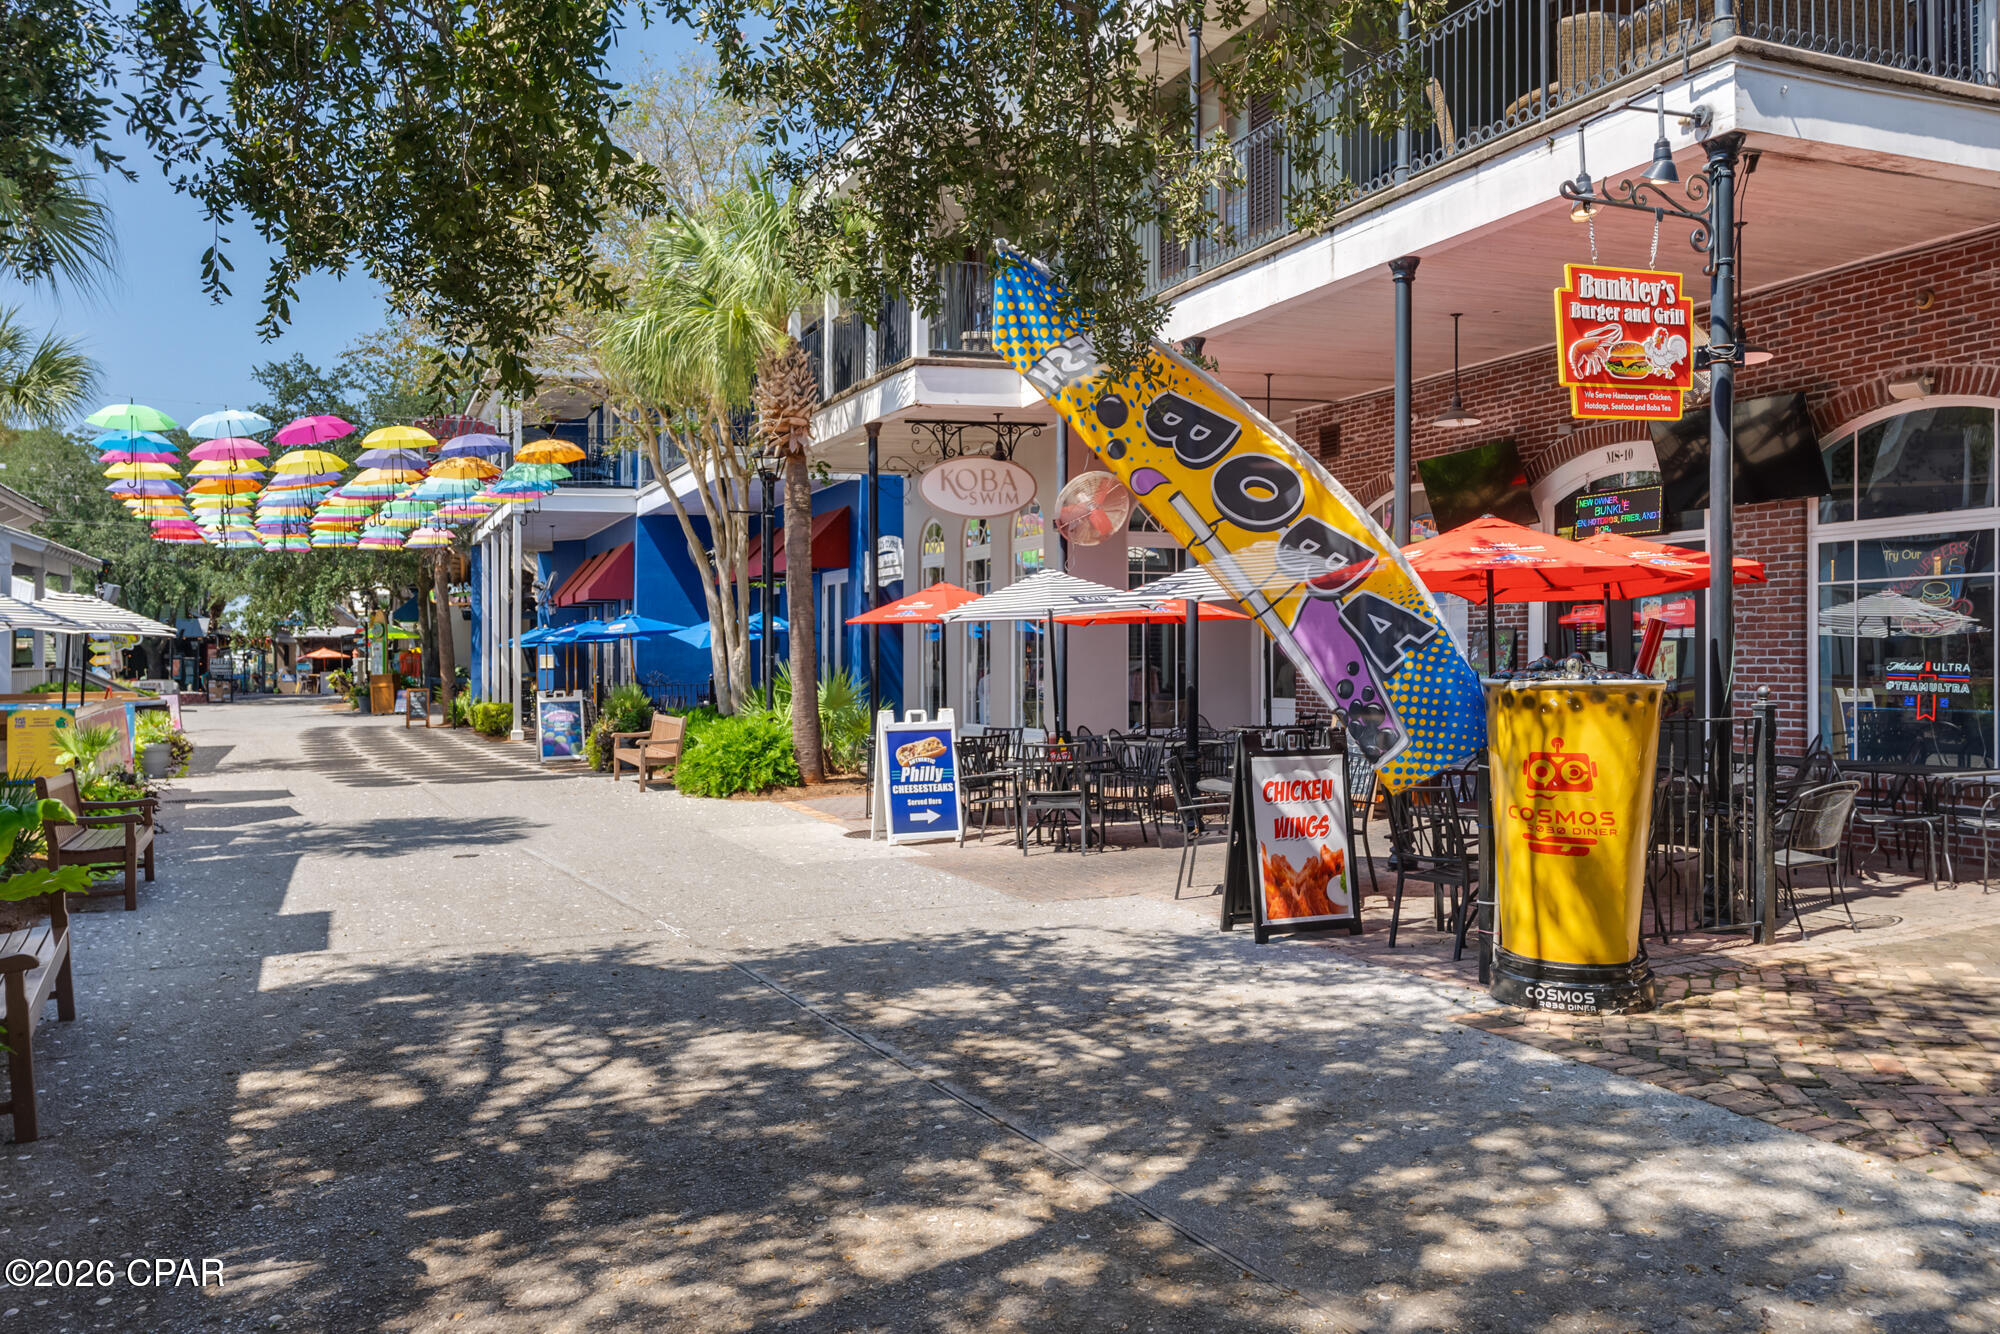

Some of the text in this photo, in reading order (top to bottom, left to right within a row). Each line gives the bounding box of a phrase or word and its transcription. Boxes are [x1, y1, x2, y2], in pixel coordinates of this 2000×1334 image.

[1578, 273, 1676, 307] Bunkley's
[1570, 302, 1685, 326] Burger and Grill
[1584, 390, 1673, 402] We Serve Hamburgers, Chicken,
[1584, 402, 1611, 412] Hotdogs,
[1611, 402, 1635, 412] Seafood
[1646, 404, 1661, 412] Boba
[1661, 404, 1672, 412] Tea
[1606, 447, 1634, 464] MS-10
[940, 468, 1018, 500] KOBA
[969, 492, 1020, 506] SWIM
[1578, 498, 1594, 508] NEW
[1883, 549, 1922, 563] Try Our
[1932, 662, 1971, 673] ULTRA
[900, 765, 944, 783] Philly
[892, 782, 954, 795] CHEESESTEAKS
[1263, 779, 1333, 803] CHICKEN
[1508, 805, 1616, 827] COSMOS
[1274, 814, 1331, 840] WINGS
[1572, 828, 1618, 837] DINER
[1525, 986, 1596, 1005] COSMOS
[1567, 1004, 1597, 1012] DINER
